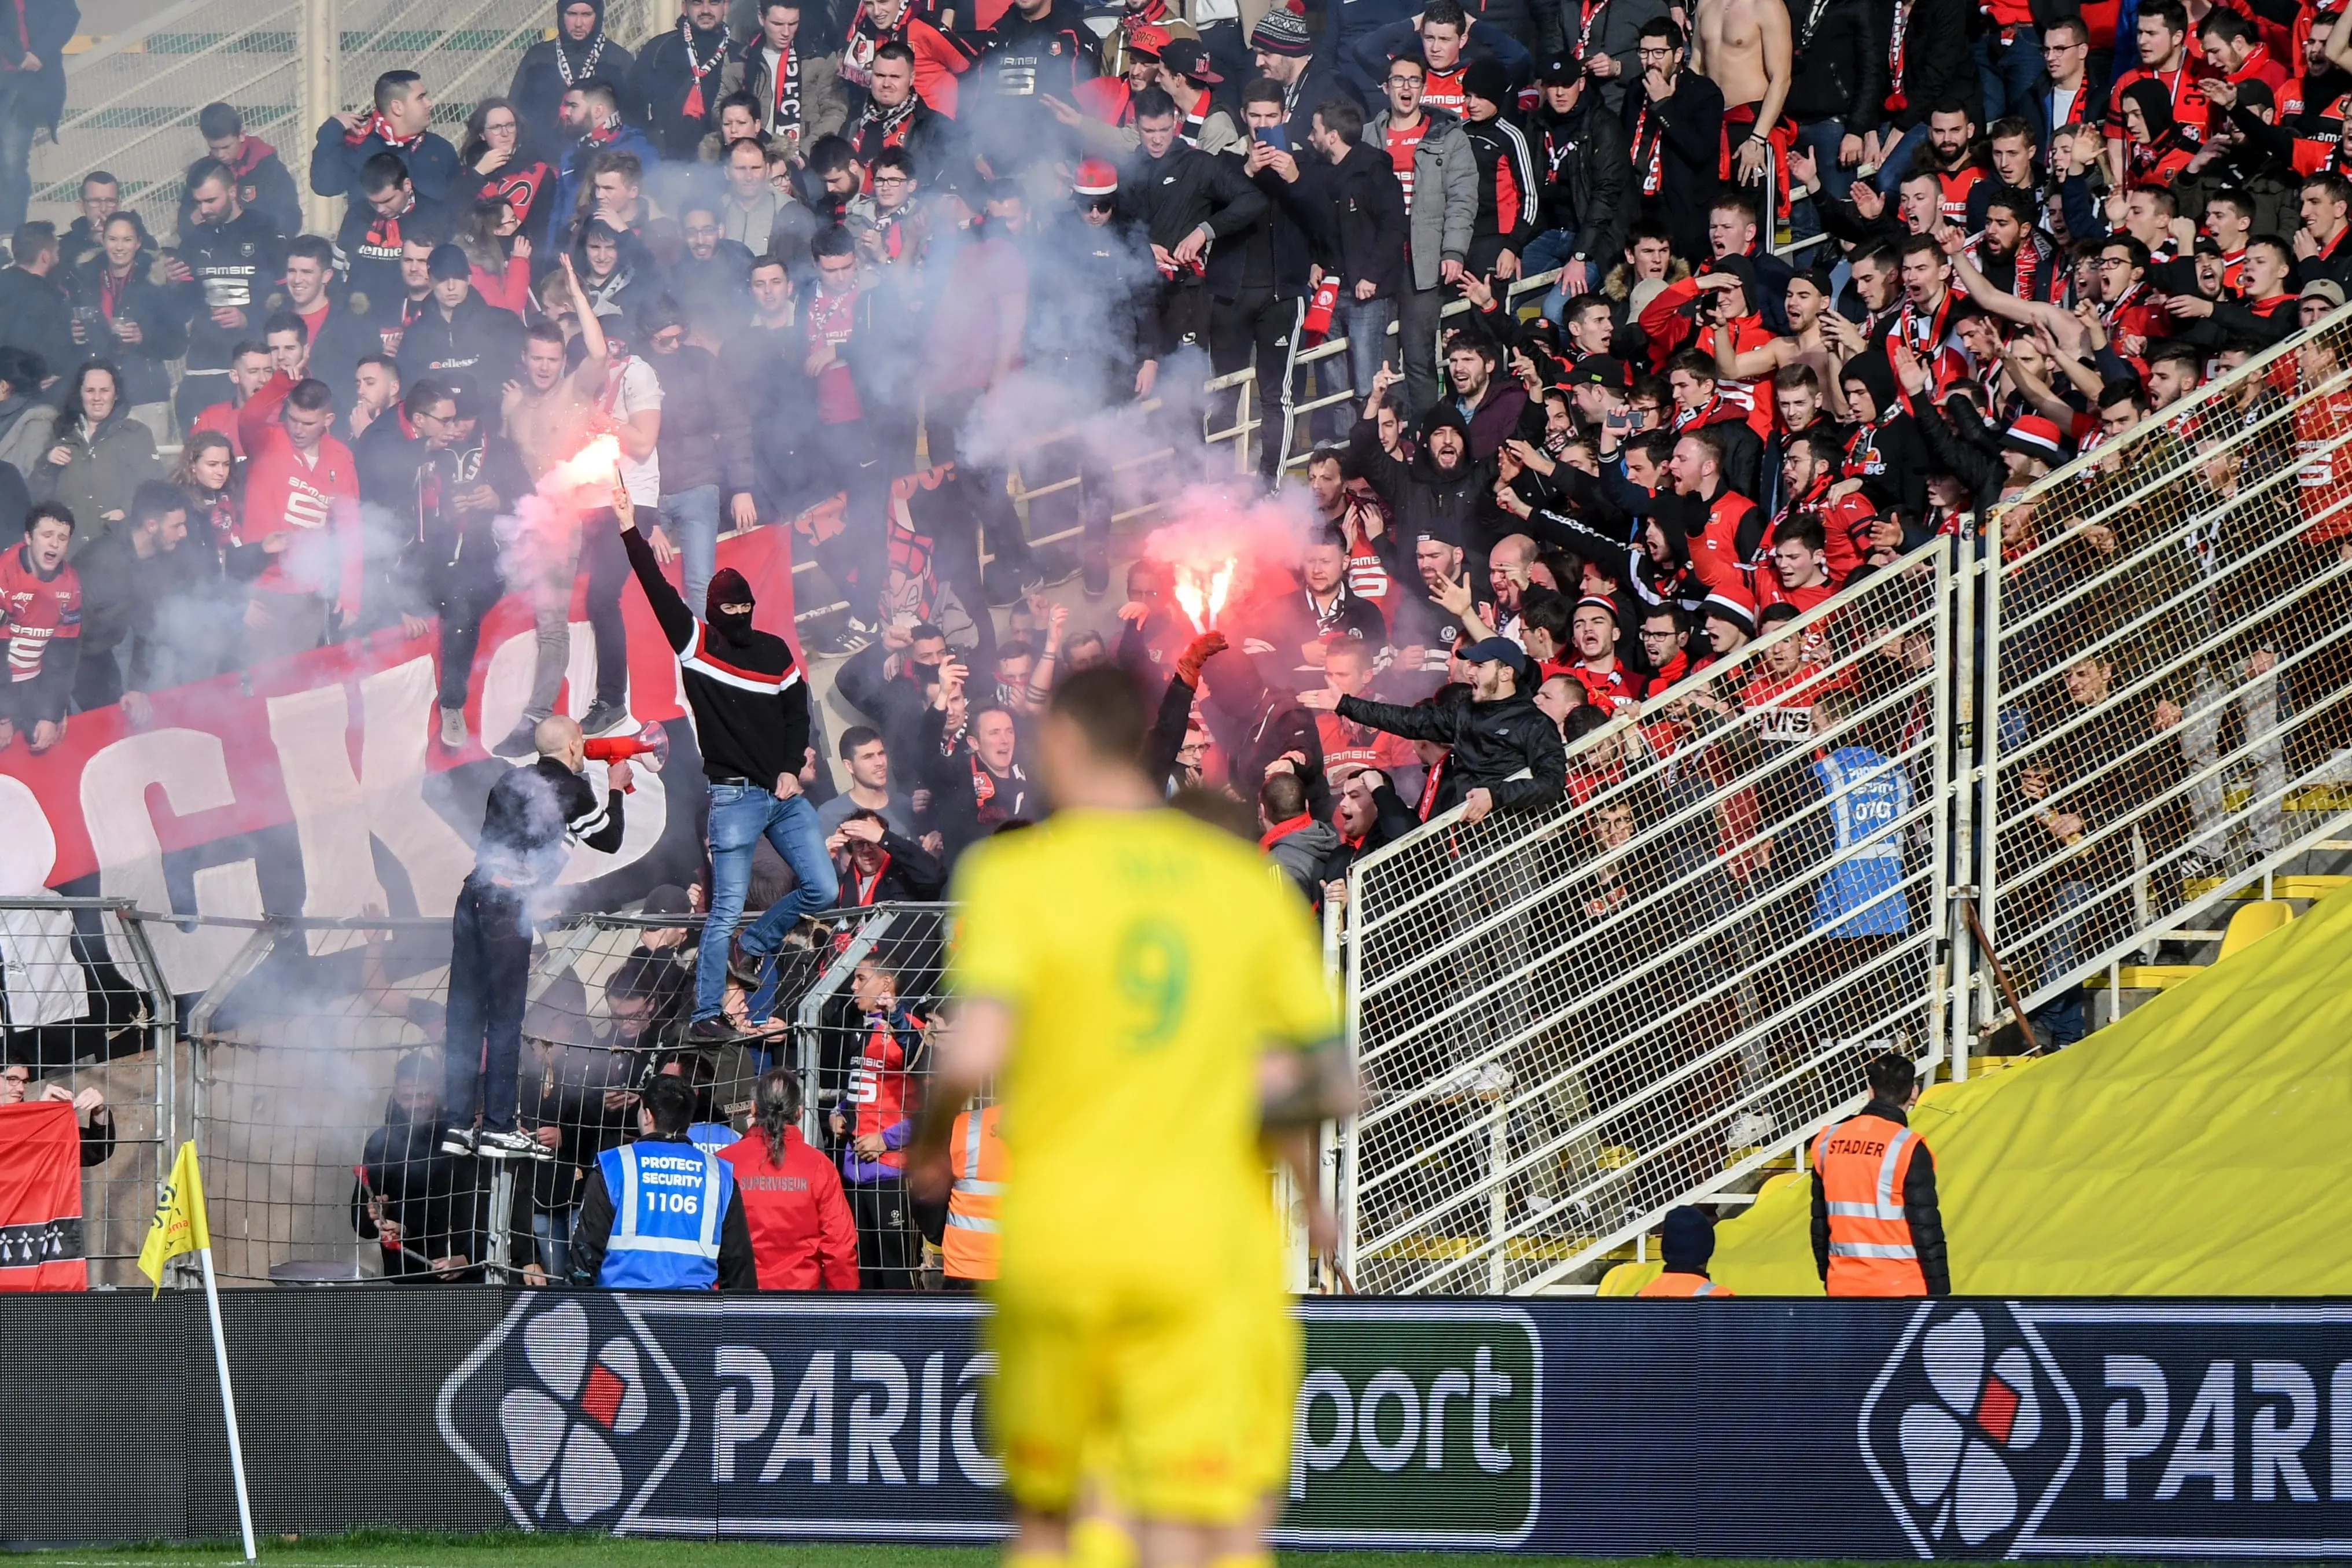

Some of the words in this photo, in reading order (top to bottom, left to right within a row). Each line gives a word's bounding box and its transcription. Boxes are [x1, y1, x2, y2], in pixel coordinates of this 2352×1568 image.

[1418, 95, 1466, 104] AMSIC
[197, 265, 256, 276] SAMSIC
[1323, 750, 1376, 764] SAMSIC
[1117, 914, 1192, 1053] 9
[1828, 1139, 1883, 1158] STADIER
[641, 1157, 703, 1173] PROTECT
[642, 1172, 703, 1188] SECURITY
[741, 1176, 808, 1192] SUPERVISEUR
[646, 1191, 698, 1214] 1106
